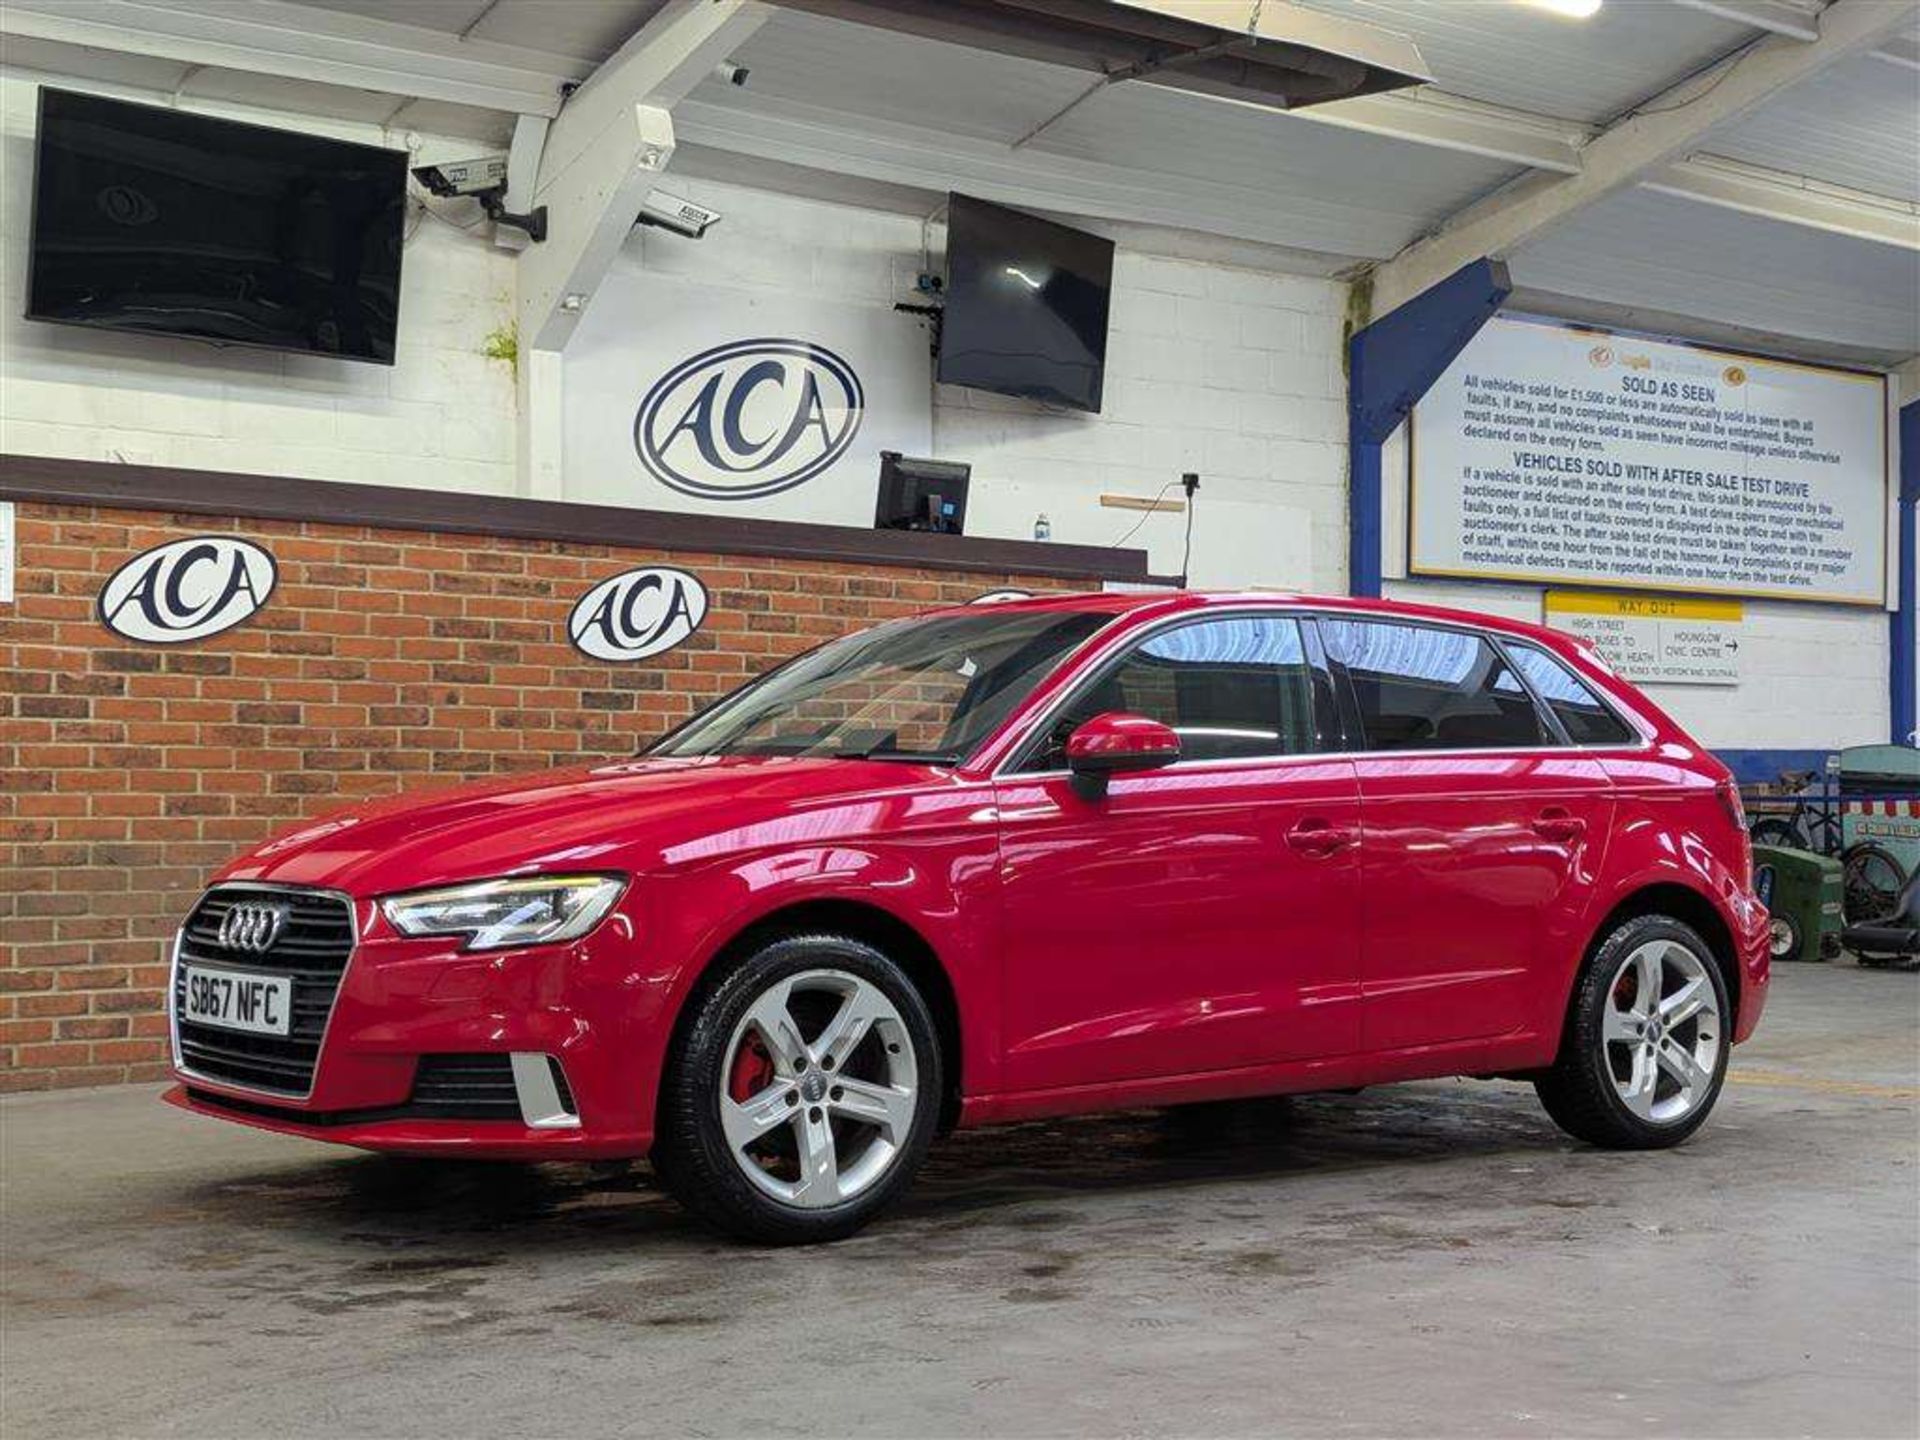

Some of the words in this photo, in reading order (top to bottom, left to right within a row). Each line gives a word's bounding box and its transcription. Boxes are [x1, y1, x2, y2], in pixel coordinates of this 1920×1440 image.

[1464, 374, 1477, 387] All
[1481, 376, 1524, 394] vehicles
[1528, 383, 1550, 397] sold
[1554, 386, 1567, 399] for
[1620, 395, 1638, 408] less
[1642, 400, 1655, 411] are
[1659, 400, 1720, 422] automatically
[1724, 409, 1743, 422] sold
[1746, 414, 1756, 424] as
[1759, 416, 1779, 427] seen
[1782, 417, 1799, 429] with
[1802, 420, 1812, 431] all
[1622, 376, 1656, 394] SOLD
[1660, 381, 1677, 398] AS
[1681, 384, 1714, 402] SEEN
[658, 360, 831, 472] ACA
[1464, 408, 1490, 421] must
[1494, 413, 1534, 427] assume
[1538, 417, 1549, 429] all
[1554, 419, 1594, 434] vehicles
[1598, 424, 1618, 437] sold
[1622, 429, 1632, 438] as
[1636, 431, 1658, 442] seen
[1661, 432, 1683, 445] have
[1686, 435, 1727, 450] incorrect
[1730, 441, 1765, 457] mileage
[1768, 445, 1796, 458] unless
[1798, 449, 1839, 463] otherwise
[1464, 424, 1509, 440] declared
[1513, 432, 1526, 442] on
[1530, 432, 1545, 444] the
[1548, 434, 1575, 450] entry
[1538, 400, 1556, 414] and
[1560, 405, 1572, 415] no
[1575, 405, 1628, 425] complaints
[1633, 412, 1685, 430] whatsoever
[1690, 420, 1710, 432] shall
[1714, 423, 1724, 434] be
[1784, 432, 1813, 448] Buyers
[1464, 466, 1471, 478] If
[1483, 468, 1520, 483] vehicle
[1537, 474, 1557, 487] sold
[1562, 477, 1582, 489] with
[1586, 481, 1597, 491] an
[1600, 481, 1622, 493] after
[1626, 483, 1644, 496] sale
[1648, 486, 1665, 498] test
[1698, 491, 1714, 502] this
[1718, 493, 1739, 505] shall
[1742, 496, 1753, 506] be
[1757, 497, 1803, 511] announced
[1806, 502, 1816, 515] by
[1819, 504, 1832, 514] the
[1514, 451, 1582, 473] VEHICLES
[1586, 459, 1621, 477] SOLD
[1626, 464, 1657, 481] WITH
[1662, 468, 1702, 486] AFTER
[1707, 472, 1738, 490] SALE
[1742, 476, 1771, 493] TEST
[1775, 480, 1808, 497] DRIVE
[1463, 483, 1518, 499] auctioneer
[1523, 489, 1541, 501] and
[1545, 491, 1588, 506] declared
[1592, 498, 1604, 507] on
[1608, 497, 1622, 509] the
[1625, 499, 1649, 514] entry
[1680, 504, 1686, 514] A
[1689, 505, 1706, 516] test
[1710, 507, 1732, 519] drive
[1736, 512, 1765, 522] covers
[1768, 515, 1792, 527] major
[1796, 516, 1843, 529] mechanical
[1464, 500, 1492, 513] faults
[1533, 506, 1549, 518] full
[1552, 508, 1568, 520] list
[1571, 509, 1580, 521] of
[1584, 511, 1611, 523] faults
[1614, 513, 1652, 527] covered
[1667, 518, 1711, 534] displayed
[1714, 523, 1722, 533] in
[1726, 524, 1739, 535] the
[1743, 526, 1767, 537] office
[1771, 528, 1786, 539] and
[1789, 530, 1807, 541] with
[1809, 532, 1822, 542] the
[1463, 533, 1473, 544] of
[1507, 536, 1537, 549] within
[1541, 541, 1560, 551] one
[1563, 541, 1586, 553] hour
[1589, 543, 1612, 555] from
[1615, 545, 1629, 556] the
[1633, 546, 1647, 558] fall
[1650, 548, 1659, 559] of
[1662, 549, 1676, 560] the
[1722, 554, 1739, 567] Any
[1742, 556, 1790, 571] complaints
[1793, 560, 1801, 570] of
[1804, 563, 1818, 573] any
[1821, 564, 1844, 575] major
[1563, 525, 1580, 537] The
[1584, 527, 1606, 539] after
[1610, 529, 1628, 541] sale
[1632, 531, 1650, 542] test
[1653, 533, 1675, 544] drive
[1680, 535, 1702, 546] must
[1706, 537, 1716, 548] be
[1719, 538, 1745, 550] taken
[1751, 541, 1786, 556] together
[1790, 544, 1807, 555] with
[1818, 547, 1851, 559] member
[109, 545, 259, 629] ACA
[1463, 549, 1523, 564] mechanical
[1526, 554, 1564, 567] defects
[1567, 557, 1592, 569] must
[1596, 559, 1607, 570] be
[1611, 560, 1651, 576] reported
[1655, 564, 1683, 576] within
[1685, 568, 1702, 577] one
[1706, 568, 1726, 579] hour
[1729, 570, 1750, 580] from
[1753, 571, 1767, 582] the
[1770, 573, 1785, 583] test
[575, 574, 694, 649] ACA
[1572, 618, 1595, 629] HIGH
[1597, 620, 1625, 630] STREET
[1618, 600, 1643, 613] WAY
[1651, 601, 1676, 614] OUT
[1623, 636, 1636, 647] TO
[1627, 652, 1655, 662] HEATH
[1665, 646, 1687, 657] CIVIC
[1691, 647, 1721, 658] CENTRE
[1674, 632, 1721, 643] HOUNSLOW
[190, 975, 233, 1018] SB67
[236, 981, 279, 1025] NFC
